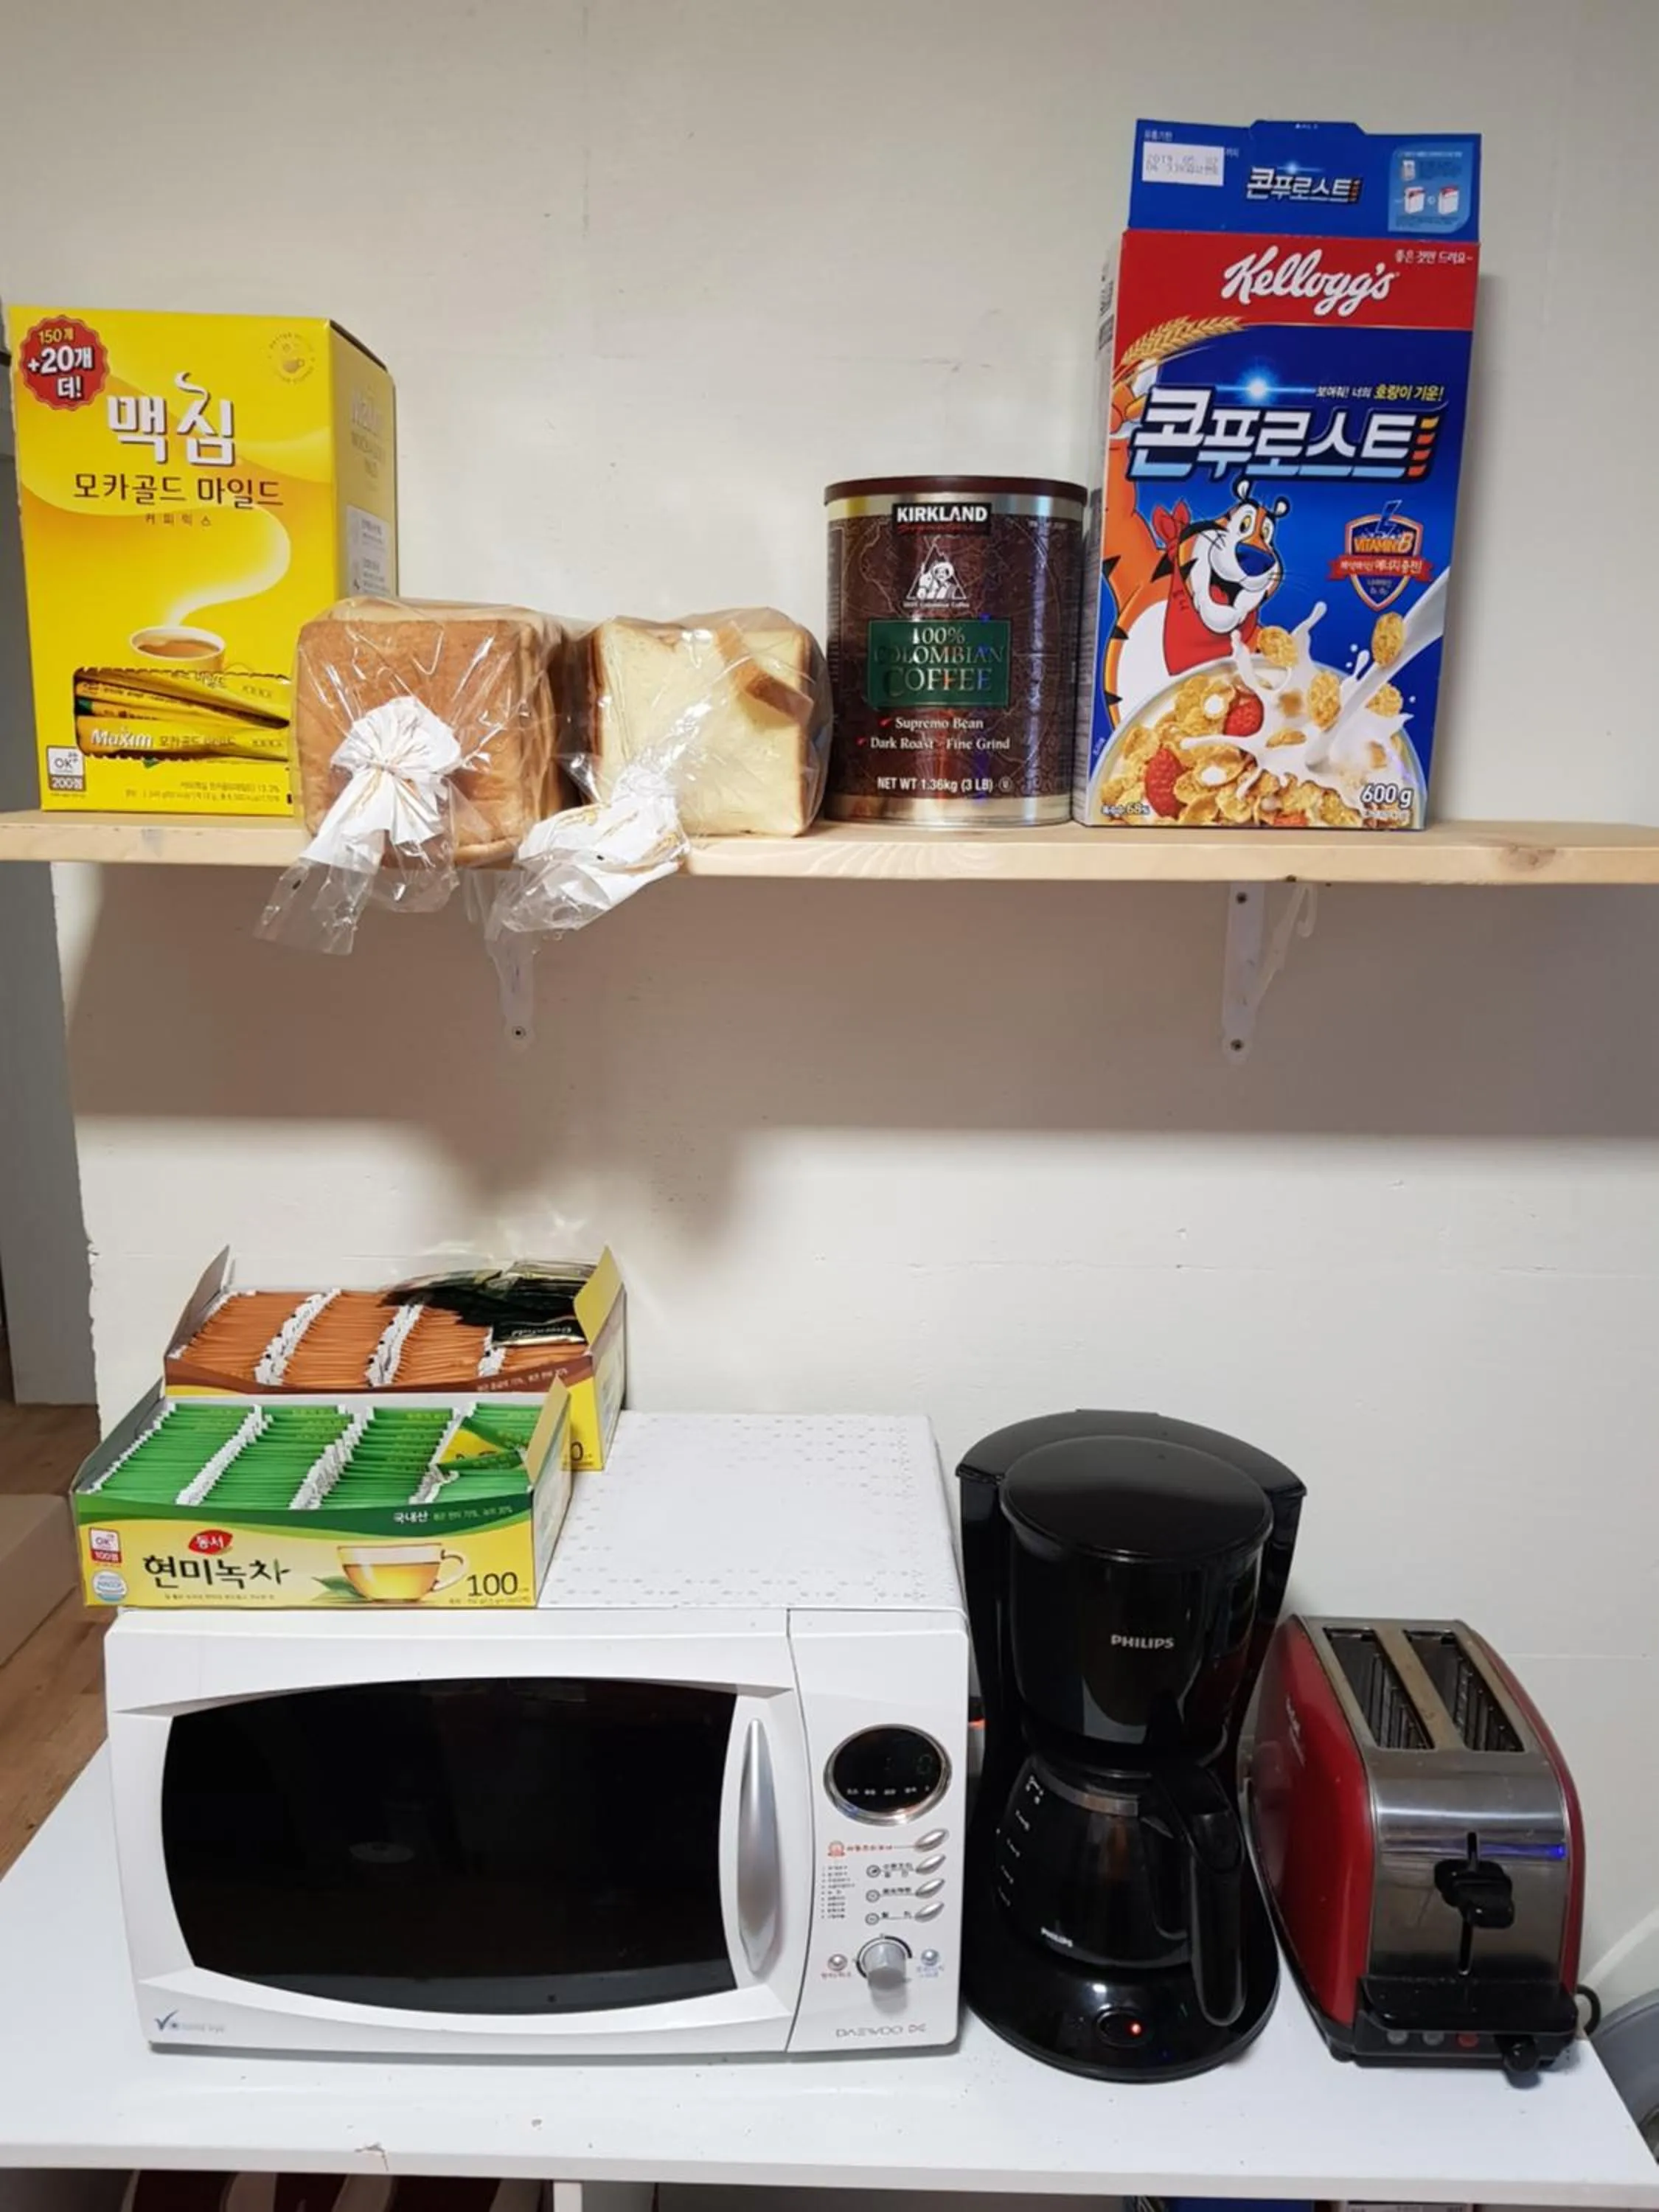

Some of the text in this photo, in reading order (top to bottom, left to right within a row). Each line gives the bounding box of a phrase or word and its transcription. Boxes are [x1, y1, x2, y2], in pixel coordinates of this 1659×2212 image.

[1247, 166, 1352, 202] 콘푸로스트
[1221, 246, 1395, 317] Kellogg's
[38, 327, 75, 344] 150개
[27, 345, 94, 375] +20개
[1374, 384, 1413, 400] 호랑이
[1413, 385, 1444, 402] 기운!
[107, 372, 234, 467] 맥심
[1130, 386, 1417, 479] 콘푸로스트
[74, 473, 285, 509] 모카골드 마일드
[897, 506, 989, 523] KIRKLAND
[912, 627, 966, 645] 100%
[887, 666, 993, 698] COFFEE
[895, 717, 984, 731] Supremo Bean
[91, 727, 153, 748] Maxim
[870, 737, 897, 749] Dark
[900, 737, 933, 750] Roast
[946, 737, 972, 750] Fine
[975, 737, 1010, 750] Grind
[877, 776, 993, 793] NET WT 1.36kg (3 LB)
[1361, 783, 1413, 810] 600 g
[142, 1554, 291, 1590] 현미녹차
[466, 1571, 518, 1597] 100
[1110, 1634, 1174, 1649] PHILIPS
